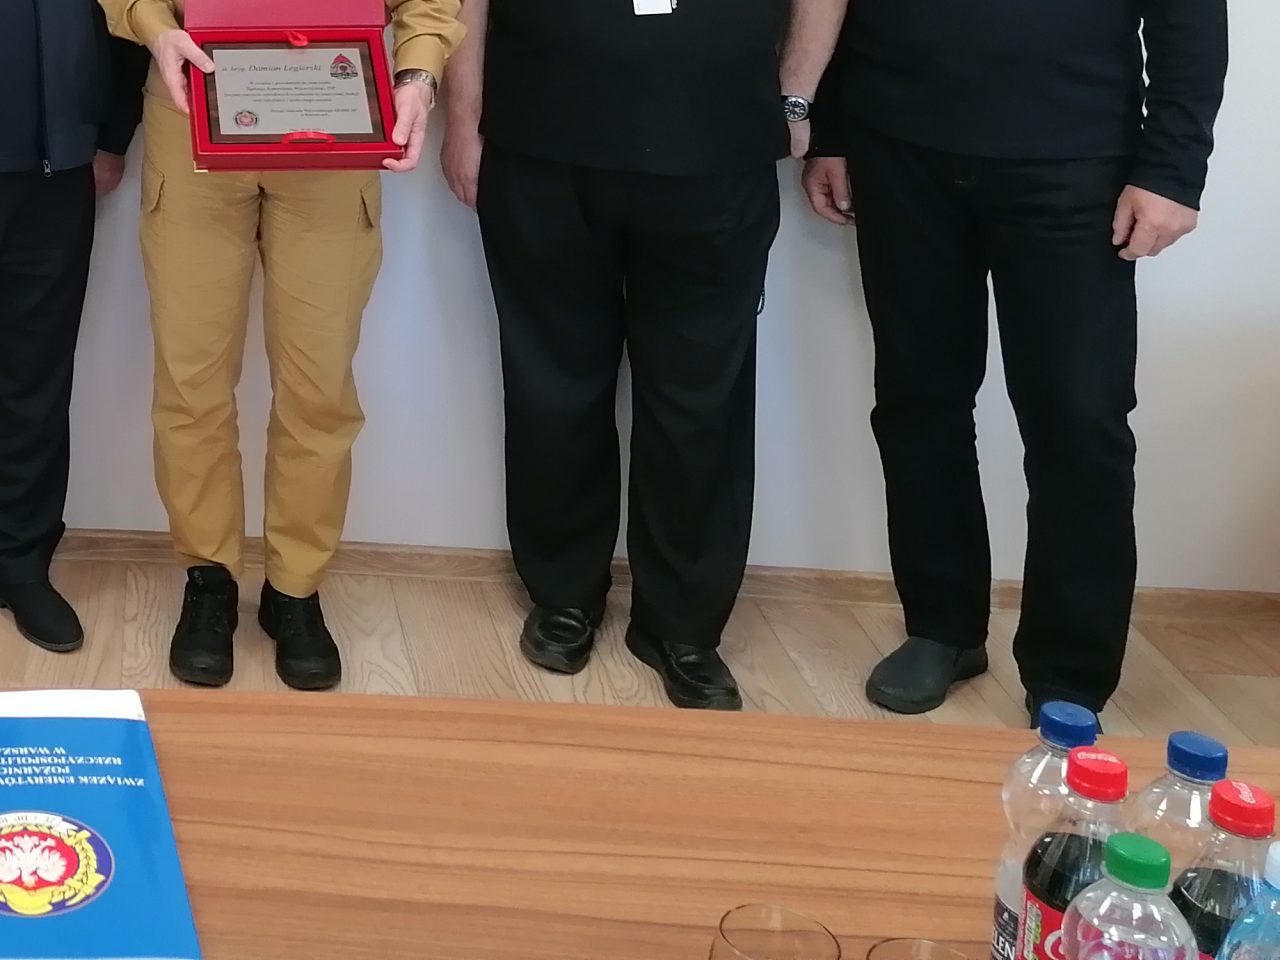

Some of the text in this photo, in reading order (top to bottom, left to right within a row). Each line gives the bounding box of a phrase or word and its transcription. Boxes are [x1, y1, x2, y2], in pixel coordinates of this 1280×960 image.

[248, 64, 282, 73] Damian
[283, 64, 322, 73] Legierski
[78, 775, 144, 786] ZWIĄZEK
